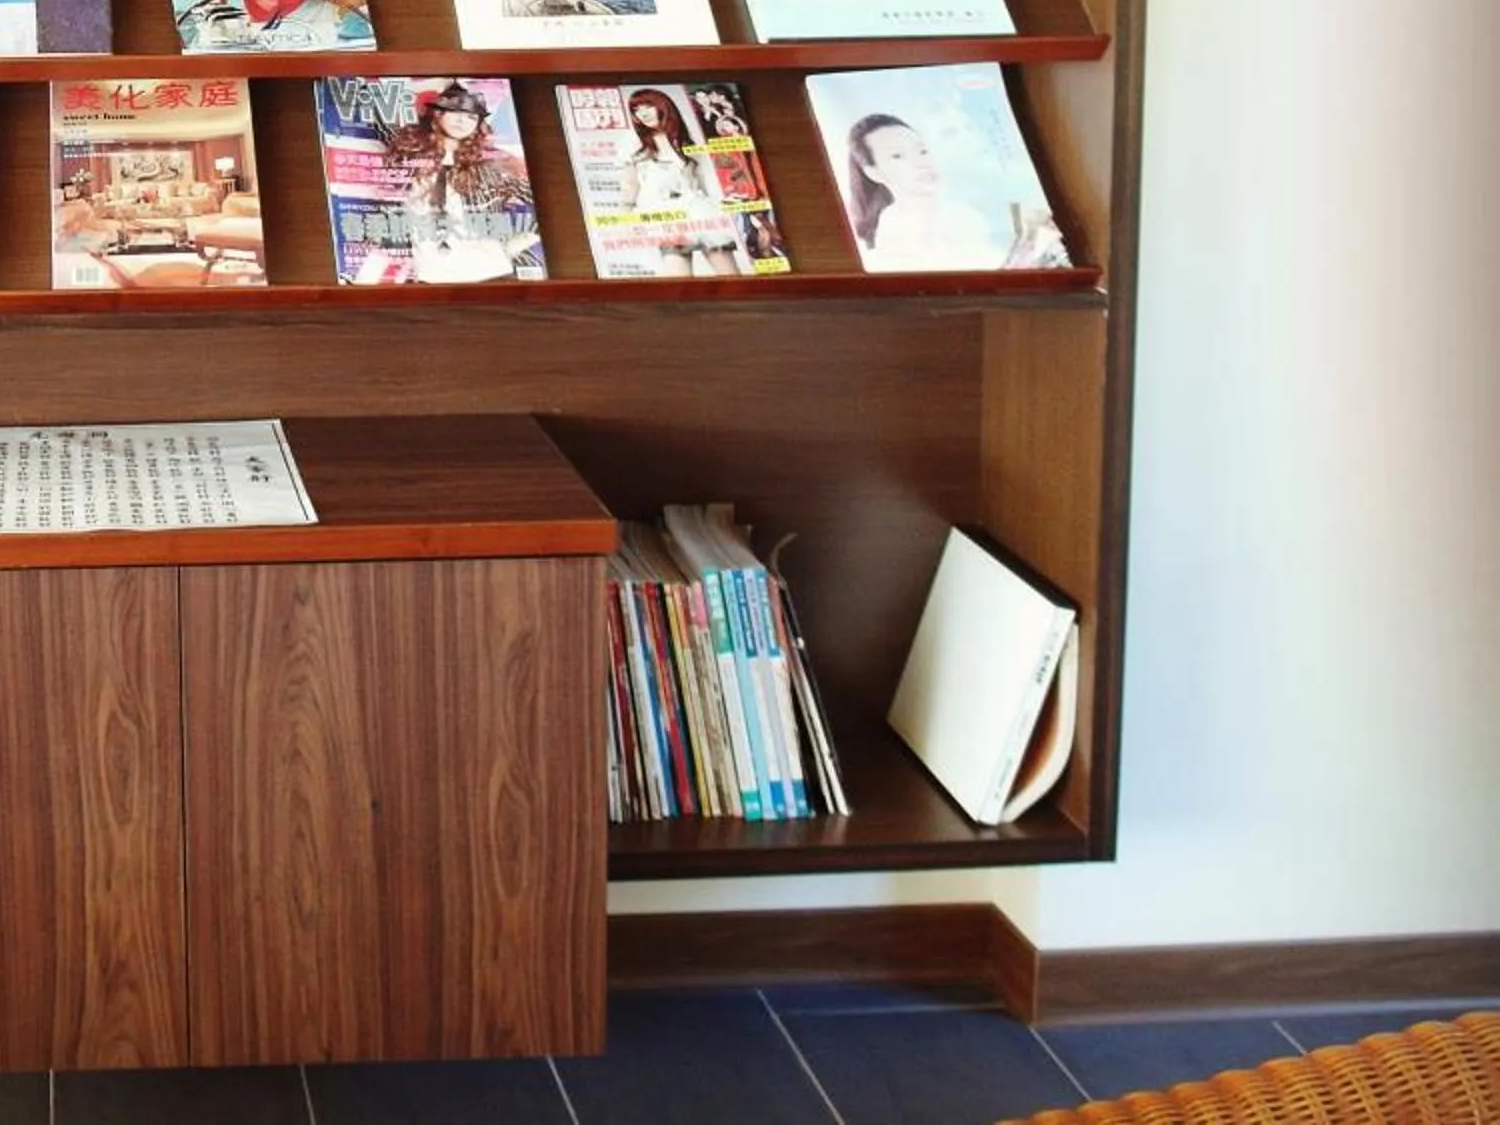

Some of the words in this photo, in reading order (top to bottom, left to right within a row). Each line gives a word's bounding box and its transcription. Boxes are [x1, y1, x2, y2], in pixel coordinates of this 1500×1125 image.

[63, 81, 238, 110] 美化家庭
[327, 75, 418, 124] ViVi
